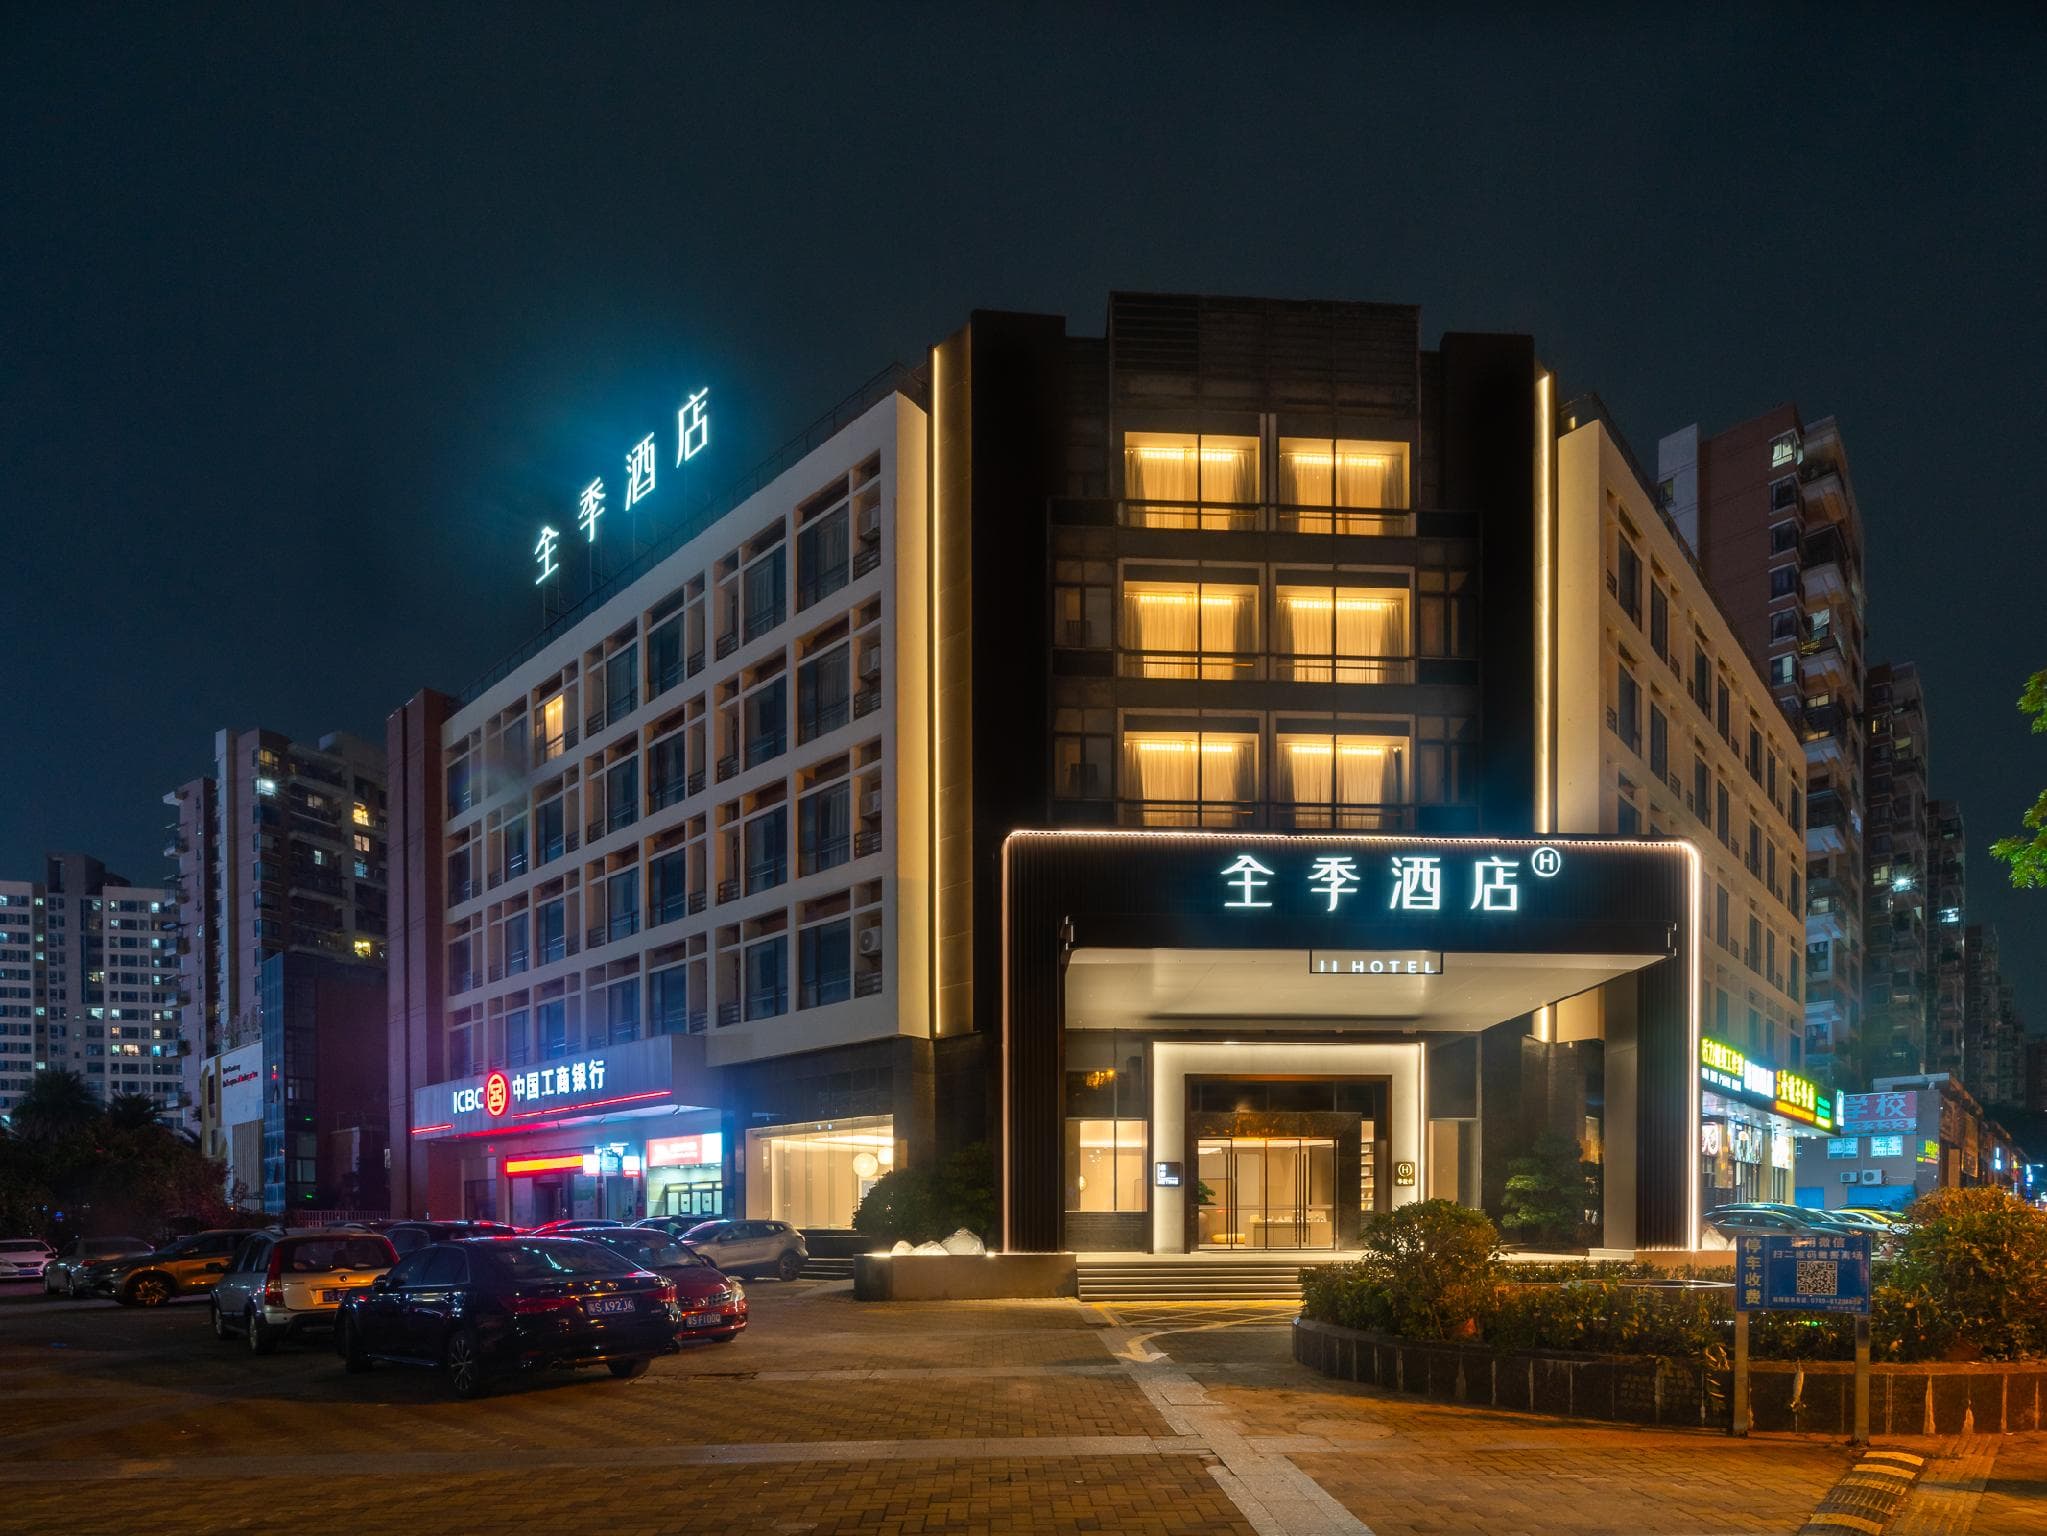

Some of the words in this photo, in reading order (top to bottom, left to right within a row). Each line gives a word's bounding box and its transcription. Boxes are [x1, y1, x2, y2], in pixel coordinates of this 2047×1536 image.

[534, 386, 709, 586] 全季酒店
[1220, 855, 1520, 912] 全季酒店
[1351, 960, 1437, 974] HOTEL
[452, 1086, 485, 1114] ICBC
[511, 1058, 606, 1102] 中国工商银行
[1744, 1238, 1762, 1305] 停车收费
